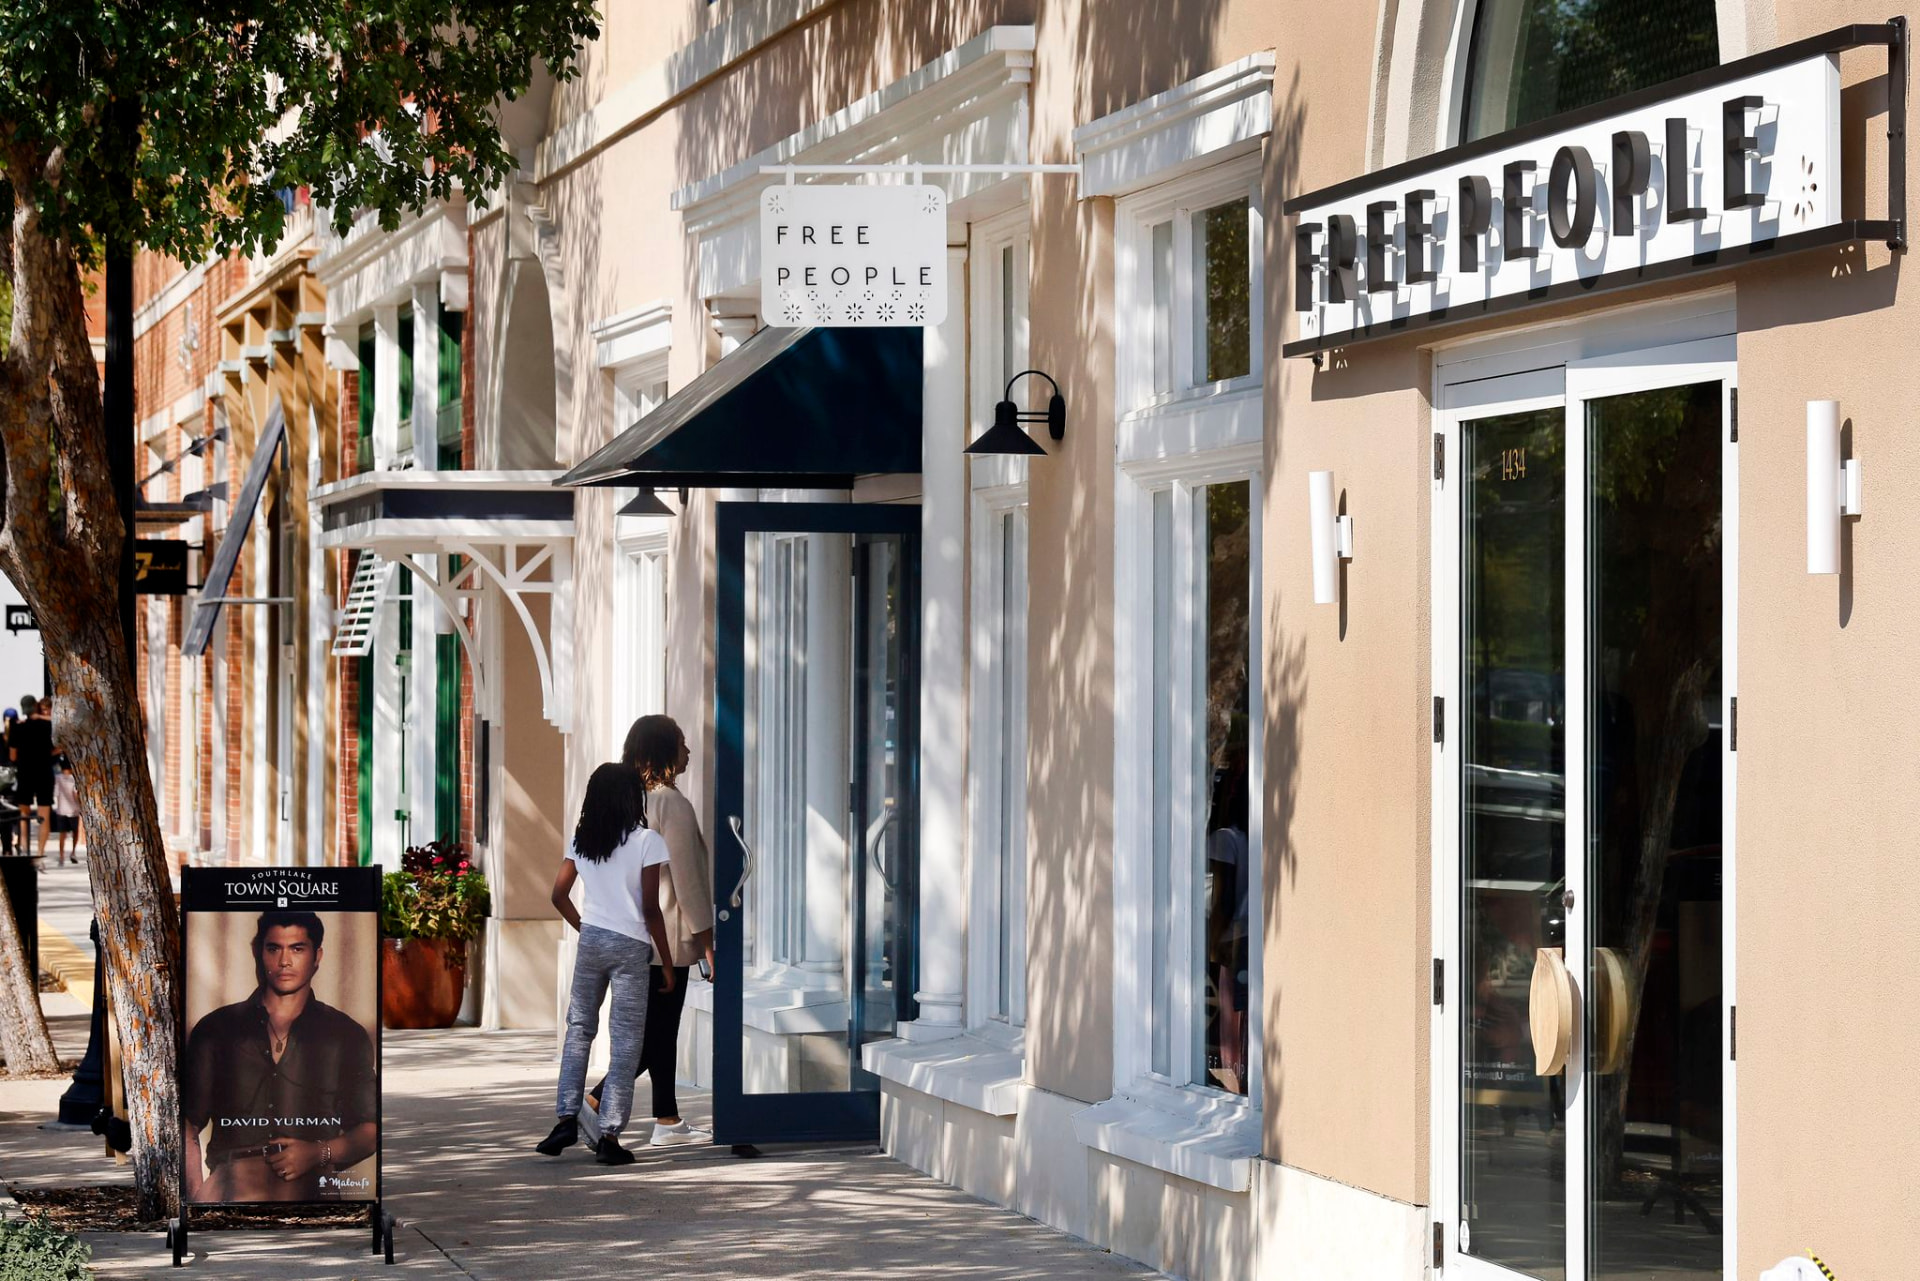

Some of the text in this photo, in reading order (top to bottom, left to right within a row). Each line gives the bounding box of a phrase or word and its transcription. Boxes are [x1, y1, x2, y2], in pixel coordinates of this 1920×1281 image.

[1295, 95, 1766, 312] FREE PEOPLE
[776, 225, 870, 245] FREE
[777, 266, 932, 286] PEOPLE
[1500, 447, 1526, 481] 1434
[251, 869, 313, 880] SOUTHLAKE
[224, 879, 339, 898] TOWN SQUARE
[220, 1117, 342, 1127] DAVID YURMAN
